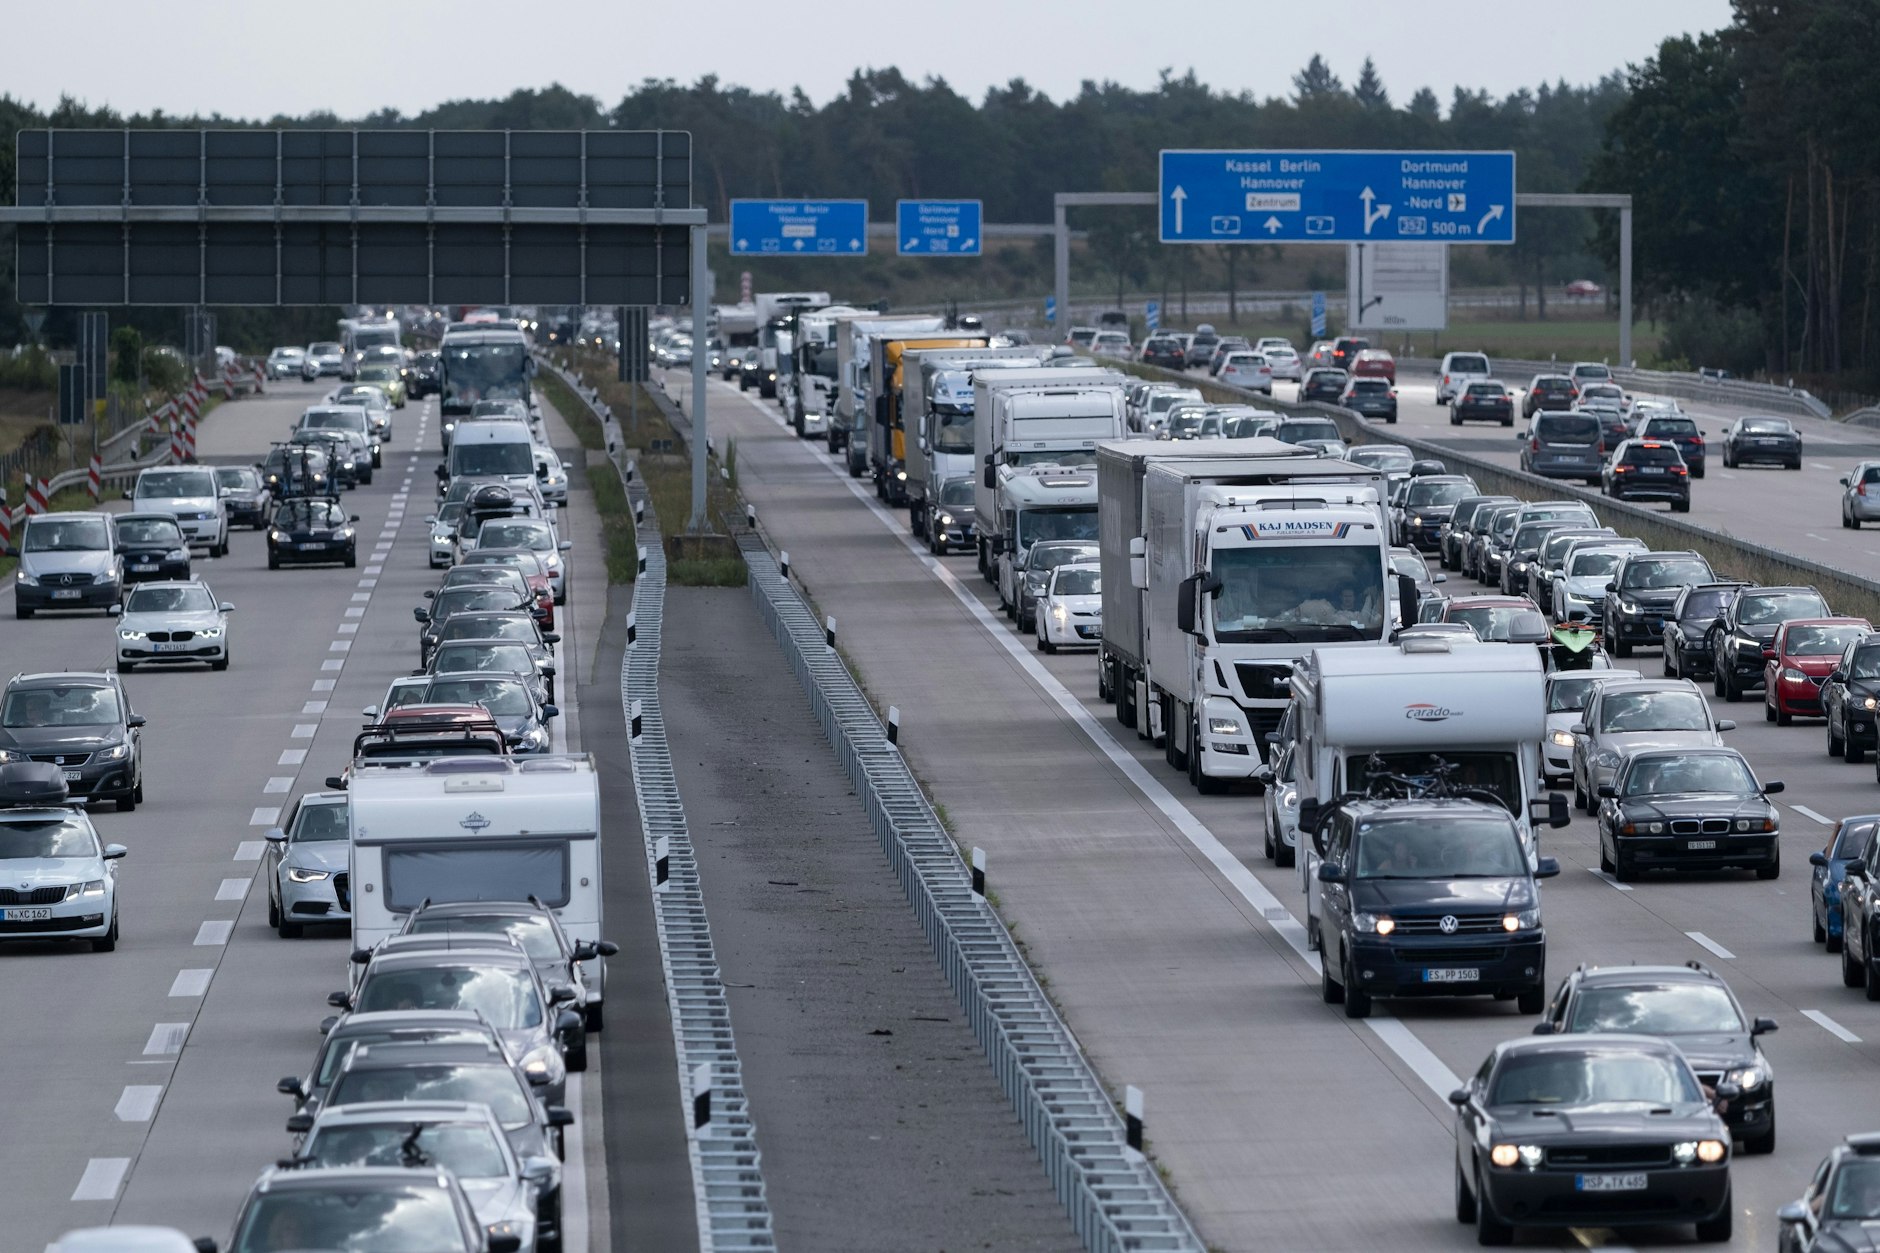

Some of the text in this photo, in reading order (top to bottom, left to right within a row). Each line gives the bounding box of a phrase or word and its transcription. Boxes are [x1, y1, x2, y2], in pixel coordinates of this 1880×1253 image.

[1225, 159, 1321, 172] Kassel Berlin
[1401, 160, 1468, 173] Dortmund
[1240, 176, 1305, 189] Hannover
[1402, 176, 1467, 189] Hannover
[1249, 196, 1297, 208] Zentrum
[1431, 221, 1472, 235] 500 m
[1285, 522, 1333, 530] MADSEN
[7, 910, 47, 919] N XC 162
[1428, 969, 1478, 979] ES PP 1503
